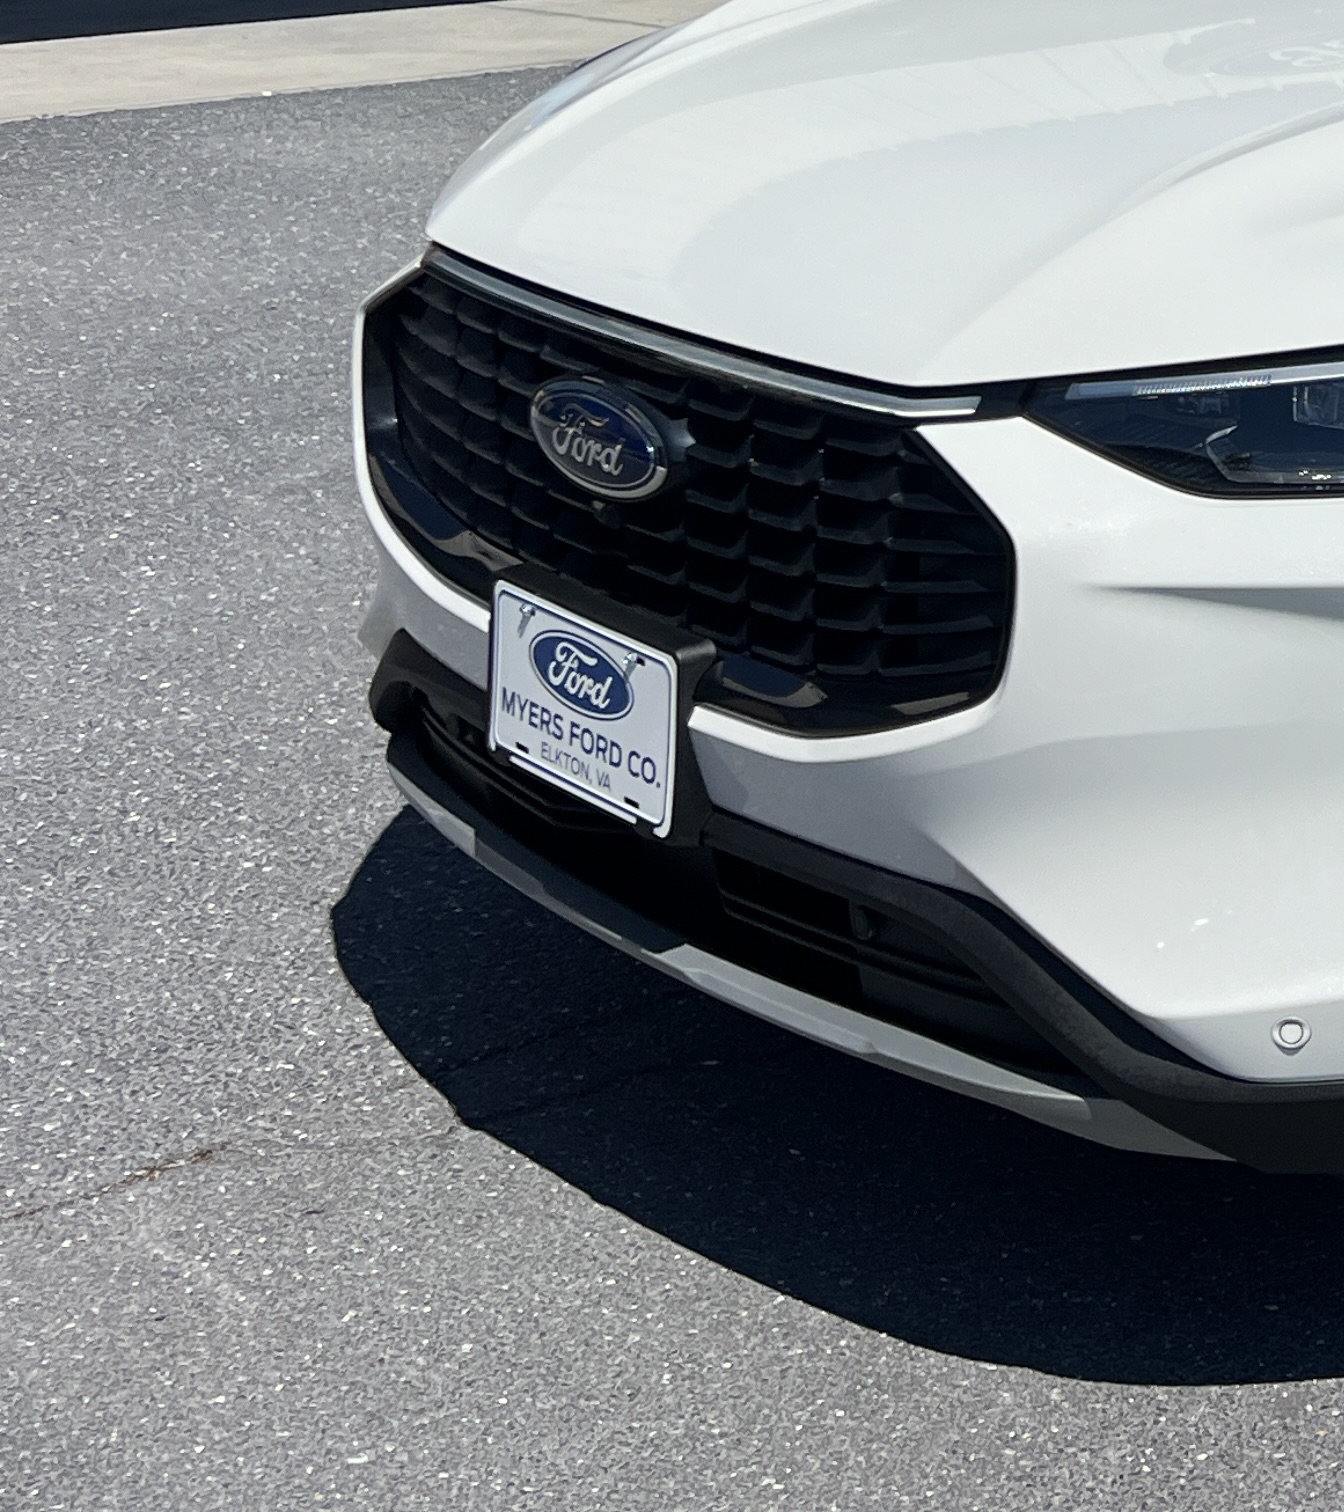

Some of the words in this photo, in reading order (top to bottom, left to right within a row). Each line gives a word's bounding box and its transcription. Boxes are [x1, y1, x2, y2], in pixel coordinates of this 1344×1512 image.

[551, 403, 625, 476] Ford
[548, 641, 614, 709] Ford
[502, 686, 564, 741] MYERS
[569, 721, 622, 768] FORD
[628, 750, 661, 788] CO.
[541, 741, 593, 785] ELKTON,
[596, 770, 612, 792] VA
